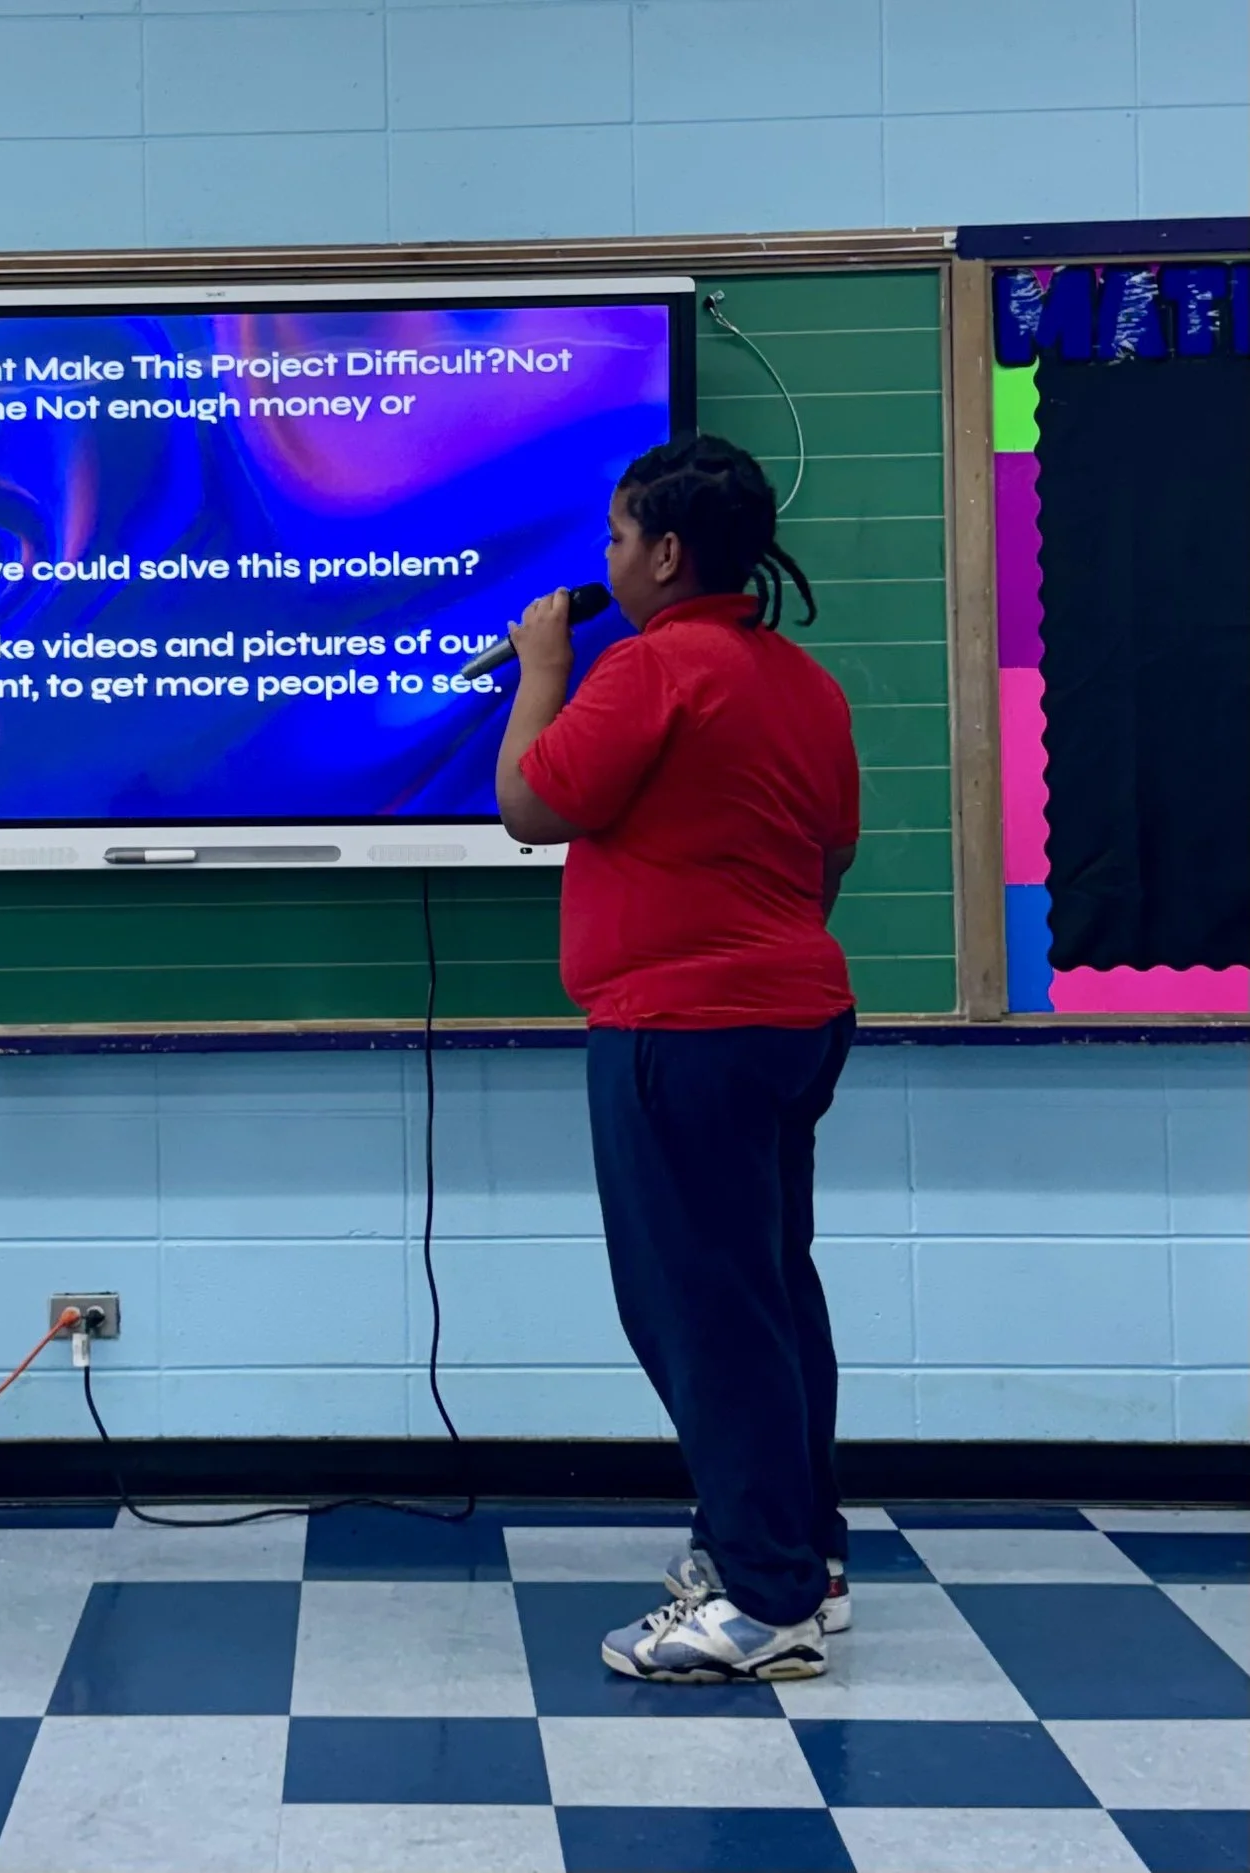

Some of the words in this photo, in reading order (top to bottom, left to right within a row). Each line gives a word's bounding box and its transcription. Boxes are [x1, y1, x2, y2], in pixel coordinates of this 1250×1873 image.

[25, 354, 125, 381] Make
[131, 352, 203, 380] This
[211, 351, 339, 384] Project
[36, 395, 101, 420] Not
[107, 391, 241, 424] enough
[249, 396, 372, 422] money
[379, 395, 416, 415] or
[31, 554, 130, 581] could
[139, 553, 230, 580] solve
[237, 551, 301, 579] this
[309, 549, 480, 584] problem?
[41, 632, 158, 659] videos
[164, 631, 234, 658] and
[243, 630, 386, 663] pictures
[394, 628, 432, 655] of
[439, 634, 499, 656] our
[45, 673, 84, 698] to
[90, 673, 149, 704] get
[155, 676, 250, 697] more
[257, 668, 379, 702] people
[386, 670, 424, 694] to
[431, 673, 502, 695] see.
